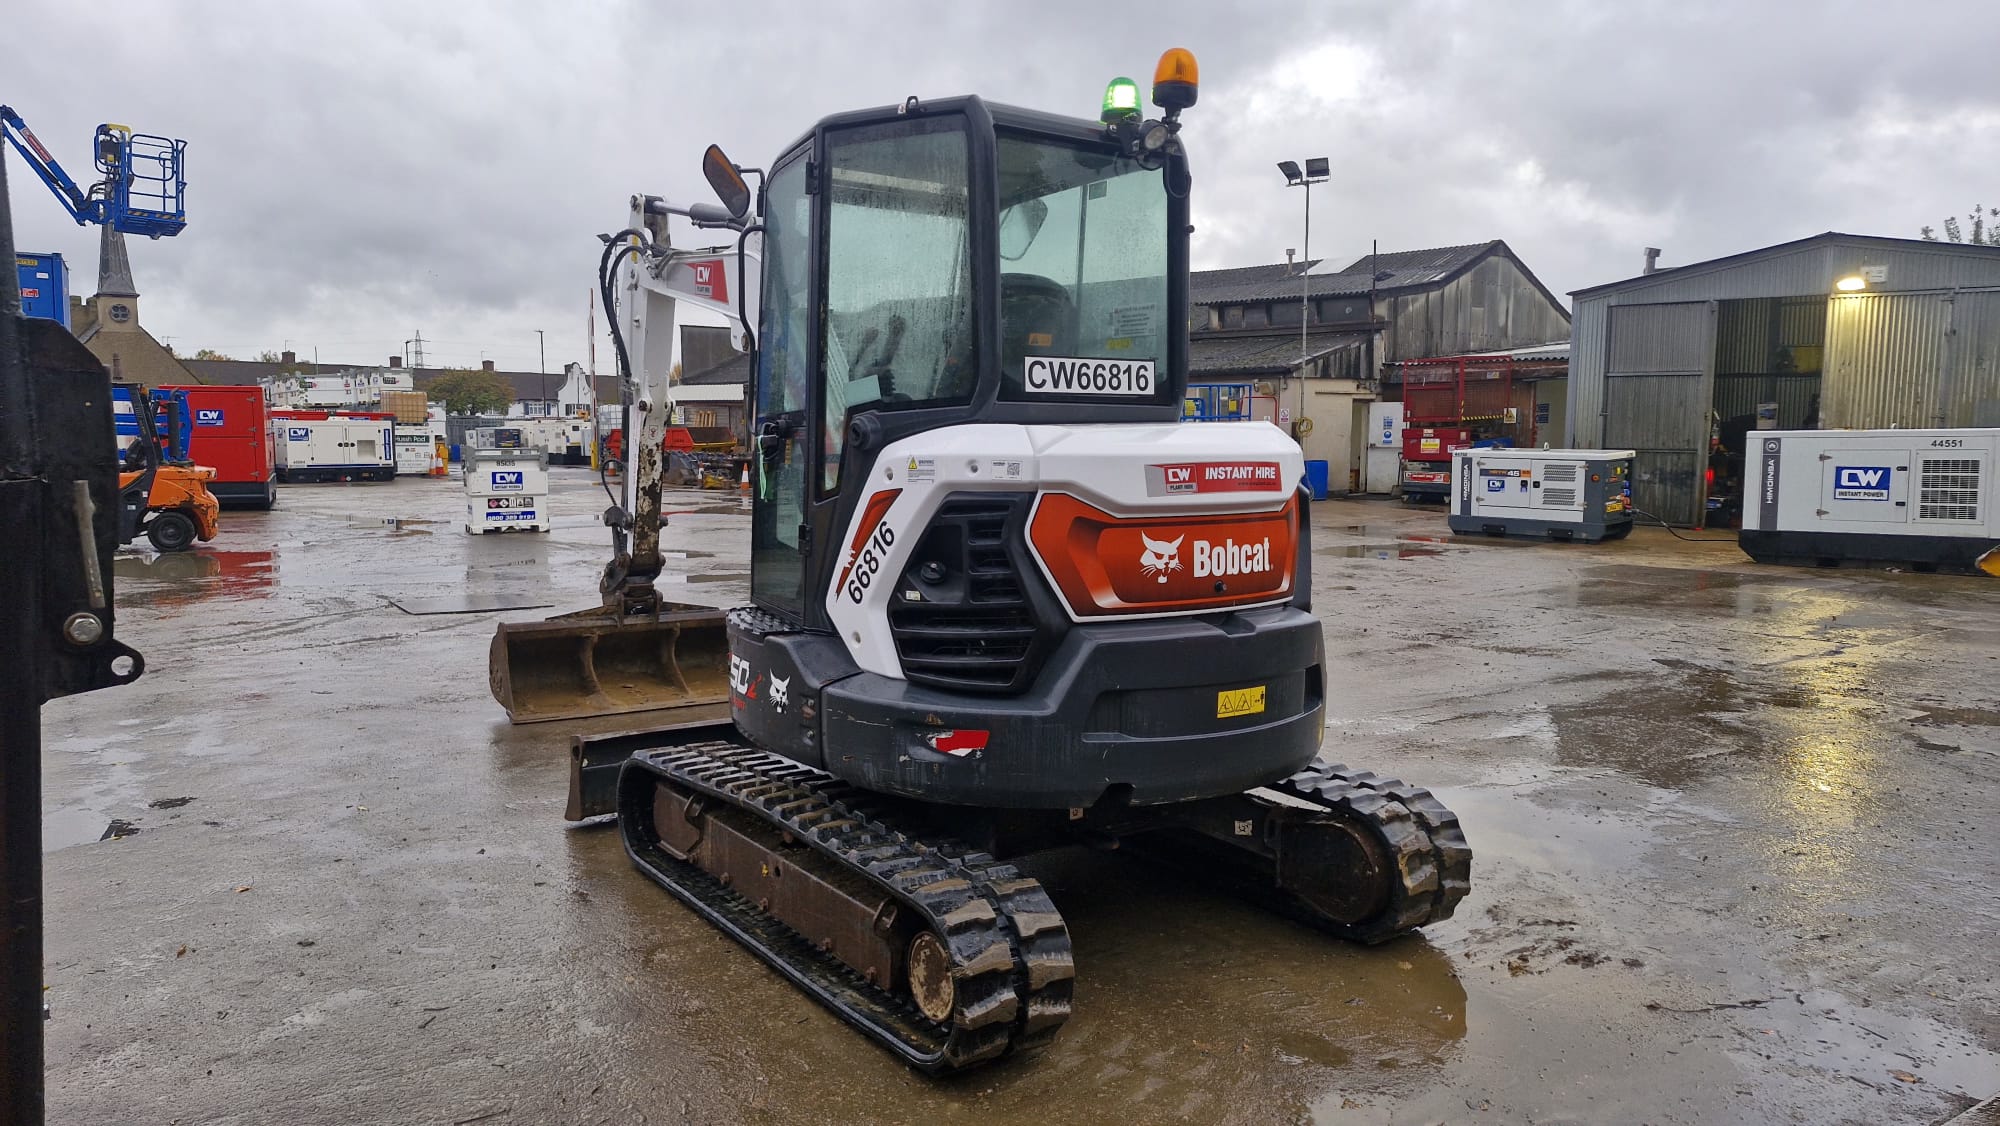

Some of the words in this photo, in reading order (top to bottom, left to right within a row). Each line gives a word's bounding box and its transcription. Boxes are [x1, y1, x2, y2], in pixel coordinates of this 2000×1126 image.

[697, 266, 711, 283] CW
[1027, 360, 1149, 391] CW66816
[199, 410, 219, 420] CW
[290, 428, 307, 437] CW
[1930, 439, 1963, 448] 44551
[496, 472, 518, 484] CW
[1168, 467, 1190, 482] CW
[1205, 466, 1253, 480] INSTANT
[1255, 466, 1276, 479] HIRE
[1841, 469, 1883, 487] CW
[1489, 480, 1503, 488] CW
[1765, 458, 1775, 504] HIMOINSA
[848, 520, 895, 605] 66816
[1193, 536, 1270, 578] Bobcat
